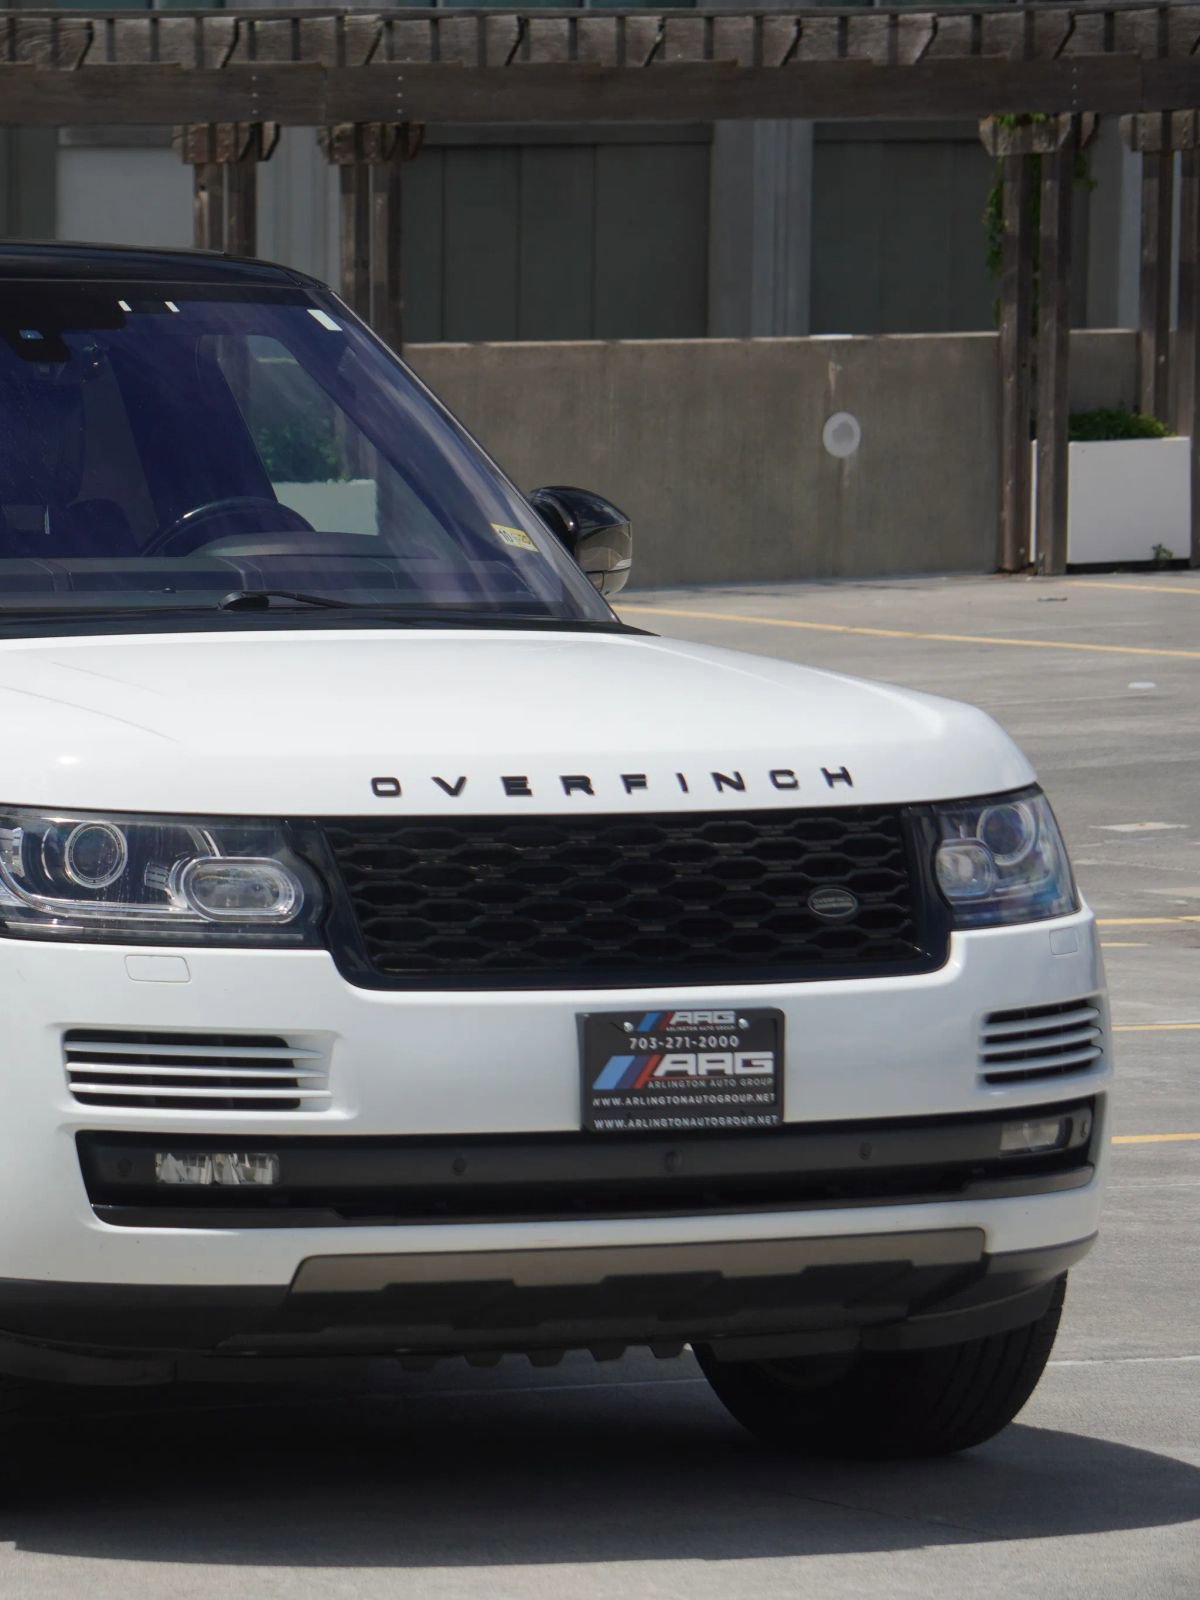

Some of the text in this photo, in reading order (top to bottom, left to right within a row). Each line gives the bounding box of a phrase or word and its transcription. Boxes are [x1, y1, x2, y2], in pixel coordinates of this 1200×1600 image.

[370, 766, 854, 797] OVERFINCH
[629, 1035, 739, 1050] 703-271-2000
[647, 1077, 774, 1089] ARLINGTON AUTO GROUP
[592, 1093, 775, 1106] WWW.ARLINGTONAUTOGROUP.NET
[594, 1115, 778, 1129] WWW.ARLINGTONAUTOGROUP.NET
